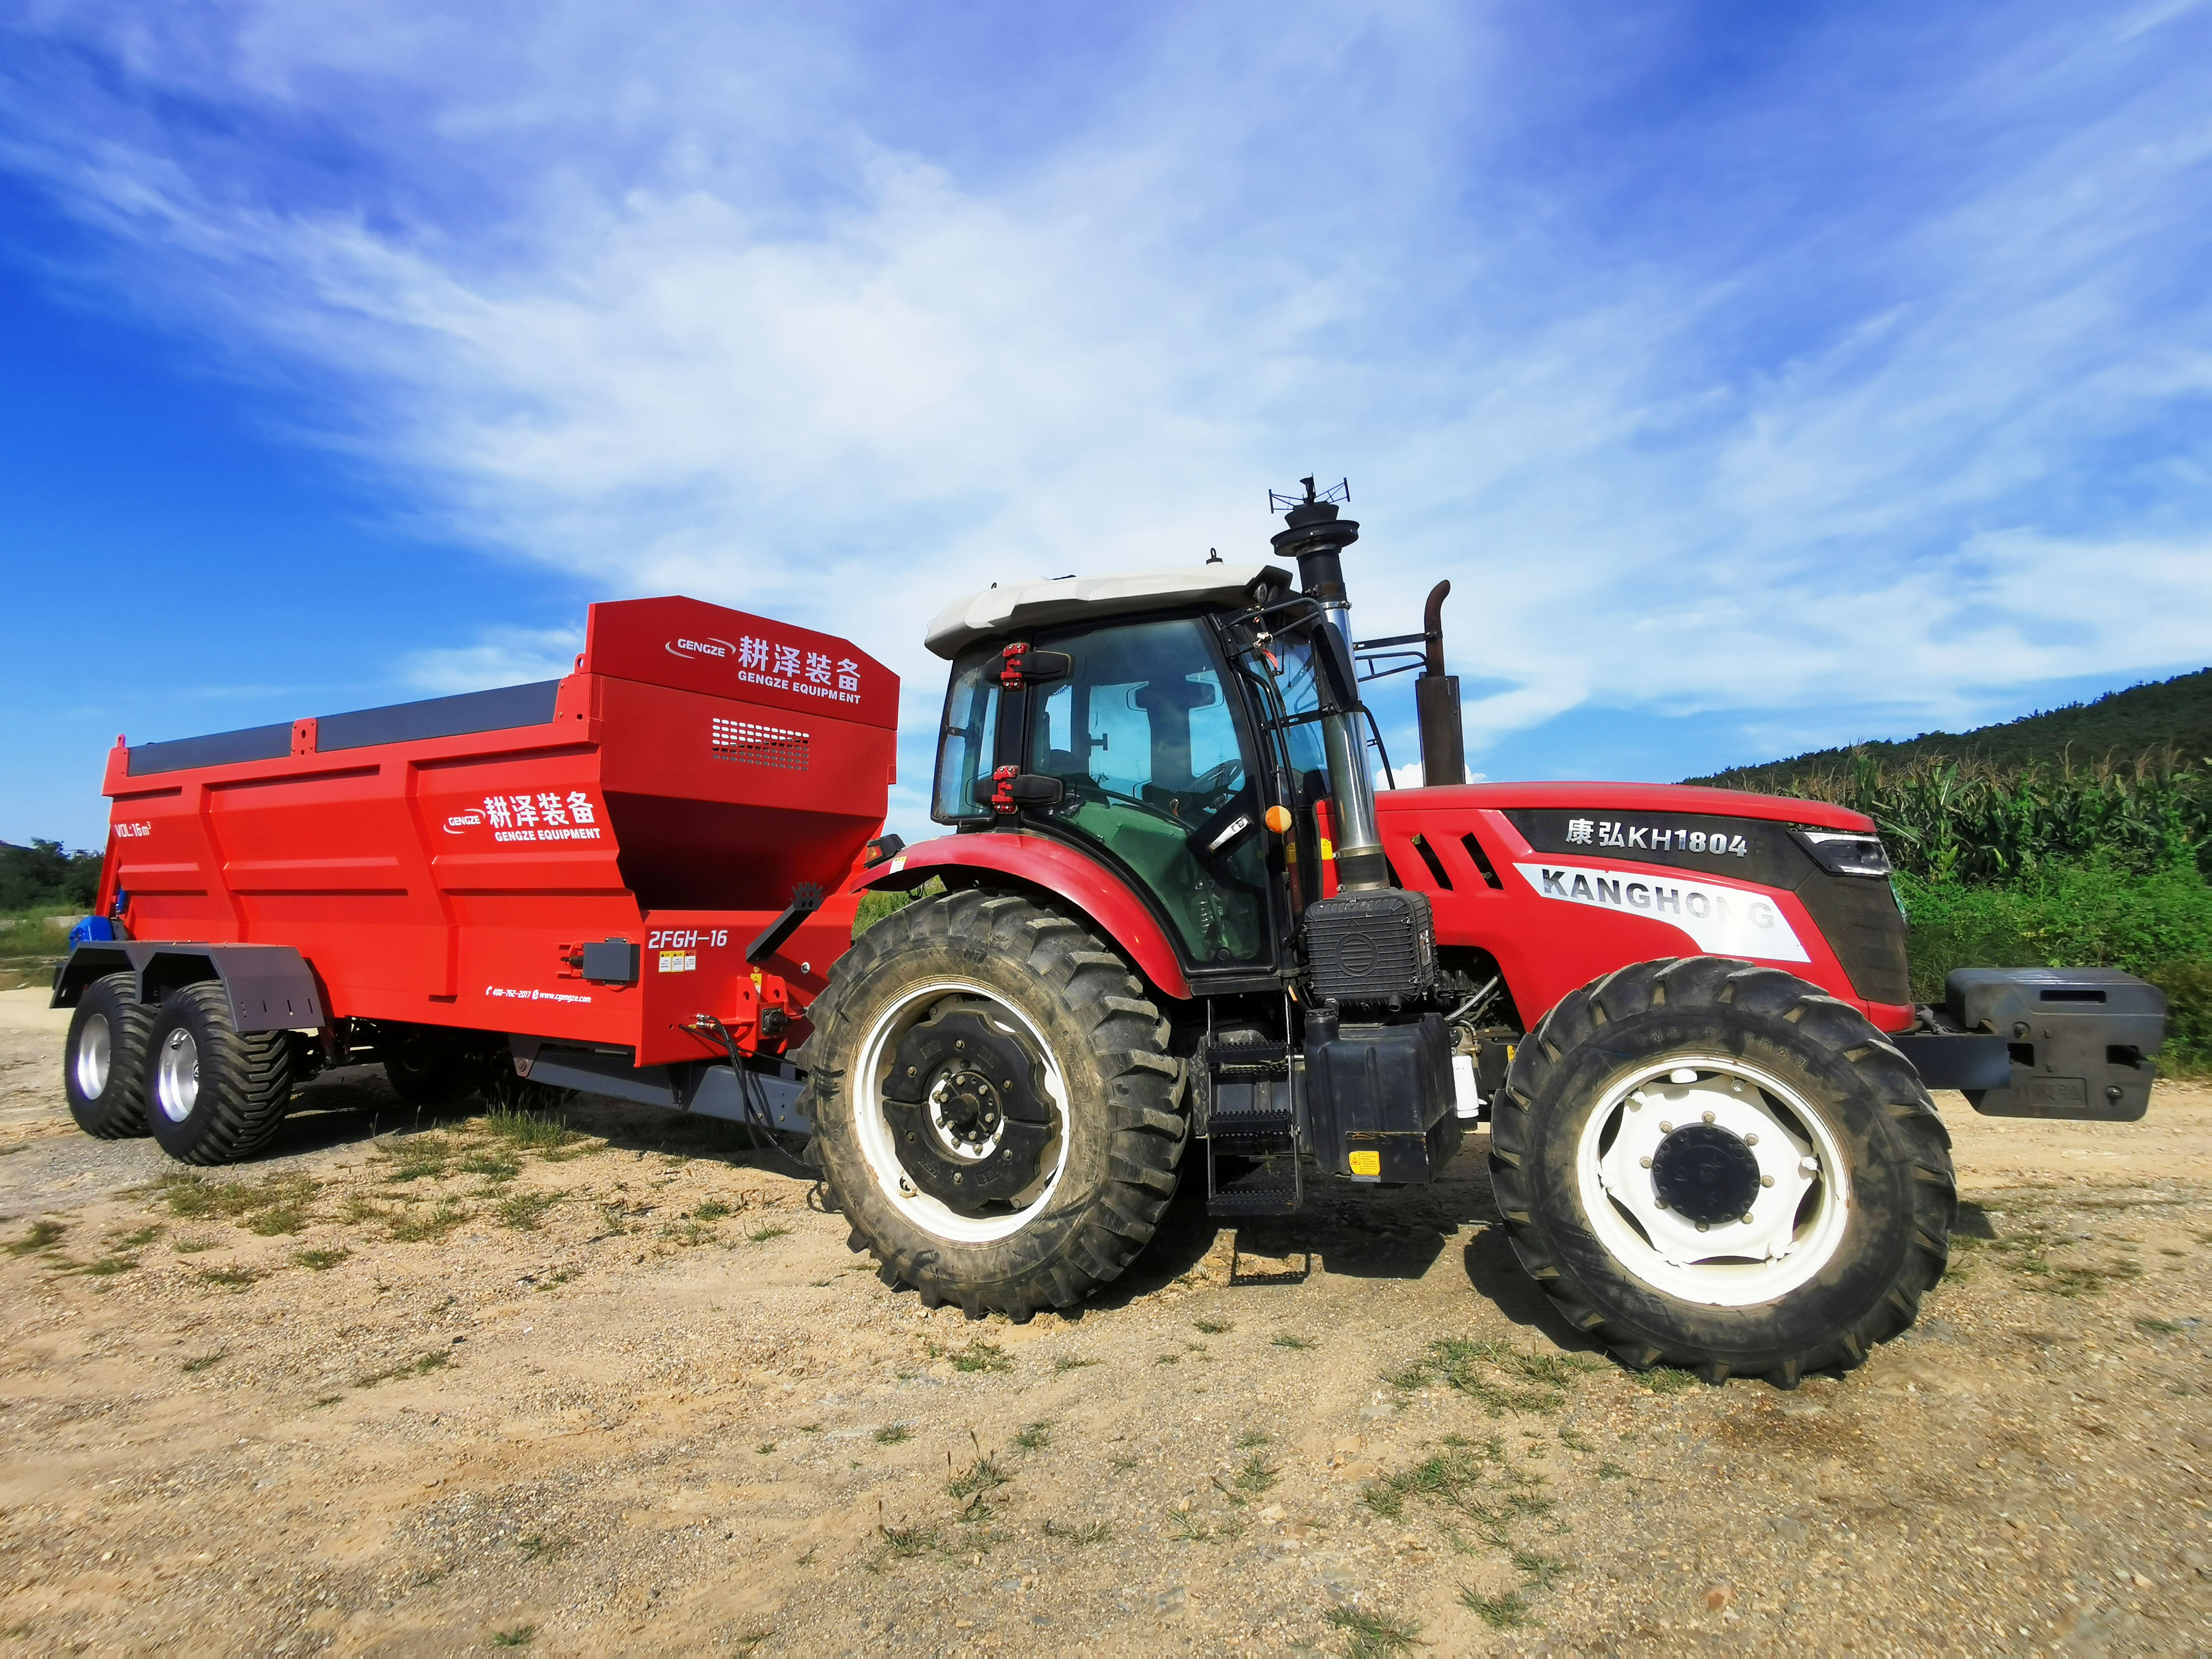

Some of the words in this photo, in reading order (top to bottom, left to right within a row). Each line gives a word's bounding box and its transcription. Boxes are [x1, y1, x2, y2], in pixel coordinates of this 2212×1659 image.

[677, 638, 725, 657] GENGZE
[738, 635, 861, 692] 耕泽装备
[738, 671, 789, 690] GENGZE
[793, 682, 861, 704] EQUIPMENT
[483, 791, 595, 829] 耕泽装备
[448, 815, 481, 826] GENGZE
[495, 830, 536, 842] GENGZE
[538, 828, 600, 840] EQUIPMENT
[1541, 868, 1775, 929] KANGHONG
[648, 930, 728, 949] 2FGH-16
[492, 988, 531, 998] 400-762-2017
[539, 992, 591, 1003] www.cgengze.com
